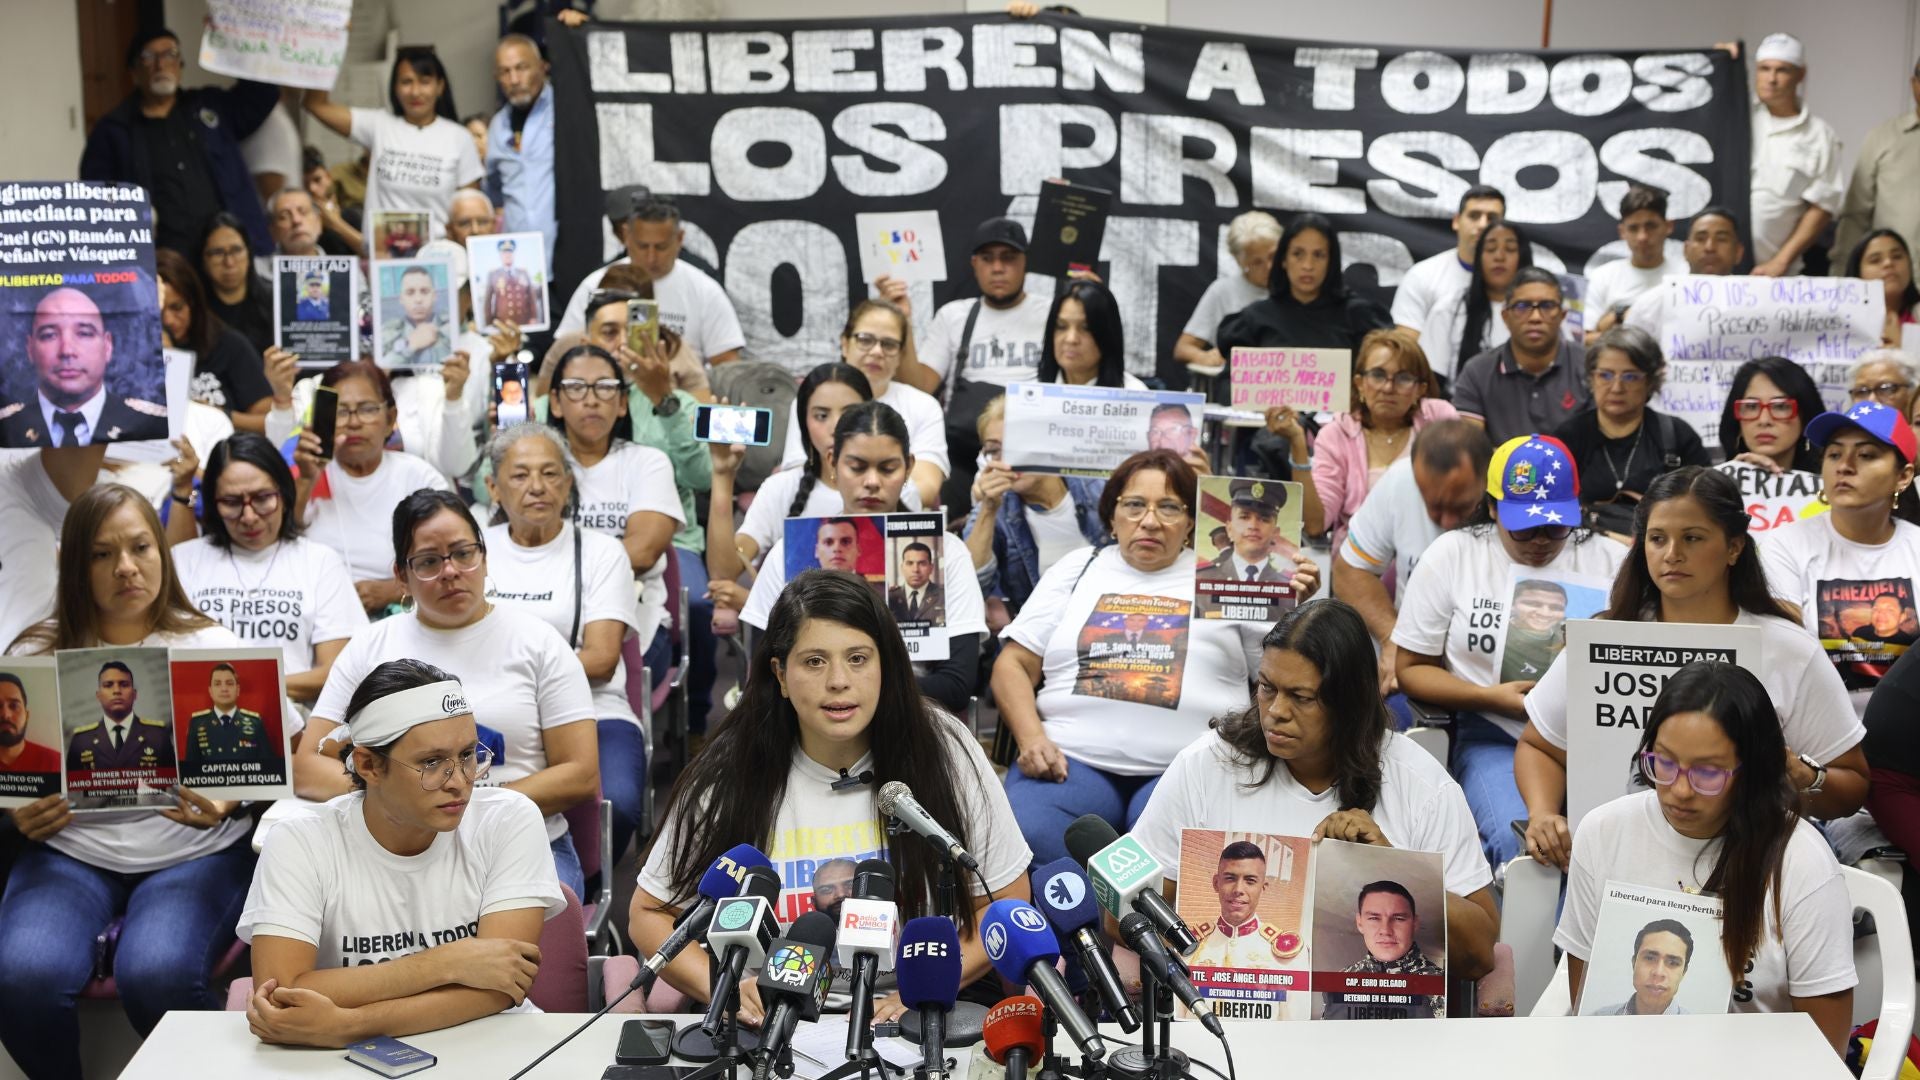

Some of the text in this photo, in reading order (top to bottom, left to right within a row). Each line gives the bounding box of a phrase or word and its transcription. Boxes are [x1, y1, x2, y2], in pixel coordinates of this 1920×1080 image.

[588, 24, 1714, 116] LIBEREN A TODOS
[596, 102, 1715, 223] LOS PRESOS
[65, 182, 145, 203] libertad
[90, 207, 138, 224] para
[31, 230, 67, 247] (GN)
[68, 227, 126, 244] Ramón
[68, 245, 138, 265] Vásquez
[280, 259, 350, 273] LIBERTAD
[1292, 353, 1317, 368] LAS
[1062, 400, 1138, 417] César Galán
[1048, 423, 1085, 438] Preso
[230, 598, 302, 617] PRESOS
[1221, 605, 1268, 620] LIBERTAD
[1594, 647, 1678, 664] LIBERTAD
[91, 769, 156, 779] PRIMER TENIENTE
[201, 762, 261, 773] CAPITAN GNB
[69, 779, 92, 788] JAIRO
[182, 773, 282, 786] ANTONIO JOSE SEQUEA
[1115, 858, 1151, 883] NOTICIAS
[1609, 890, 1715, 916] Libertad para Henryberth
[342, 931, 414, 954] LIBEREN
[418, 932, 430, 949] A
[1192, 970, 1208, 982] TTE.
[1211, 971, 1231, 983] JOSE
[1232, 973, 1257, 984] ANGEL
[1345, 977, 1361, 987] CAP.
[1208, 988, 1236, 998] DETENIDO
[1236, 989, 1244, 998] EN
[1245, 989, 1252, 999] EL
[1343, 993, 1371, 1003] DETENIDO
[986, 1002, 1037, 1024] NTN24
[1212, 1000, 1273, 1020] LIBERTAD
